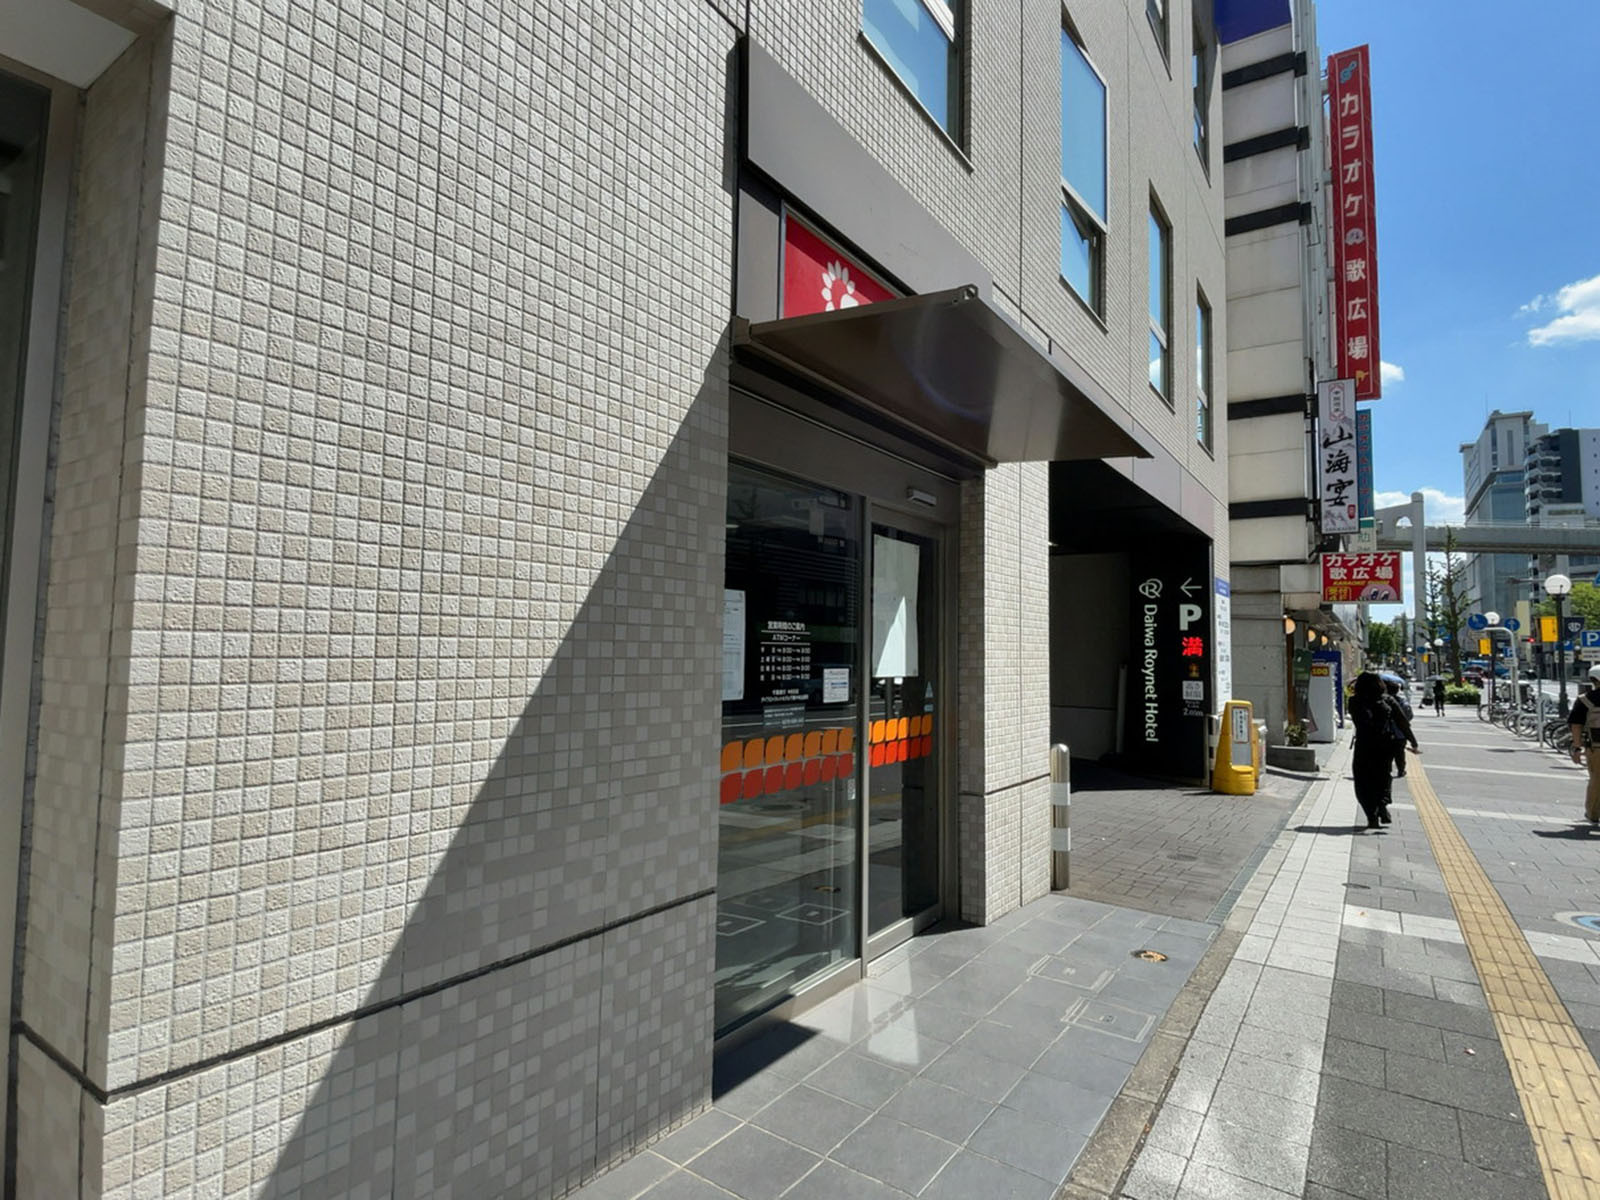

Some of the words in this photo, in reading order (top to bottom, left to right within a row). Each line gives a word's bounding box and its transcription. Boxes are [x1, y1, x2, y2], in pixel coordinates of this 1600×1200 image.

[1341, 92, 1362, 217] カラオケ
[1346, 258, 1368, 360] 歌広場
[1326, 553, 1397, 566] カラオケ
[1329, 566, 1393, 579] 歌広場
[1144, 604, 1158, 647] Daiwa
[1179, 604, 1202, 631] P
[1182, 636, 1203, 656] 満
[1586, 632, 1599, 646] P
[1141, 650, 1158, 700] Roynet
[1145, 702, 1158, 742] Hotel
